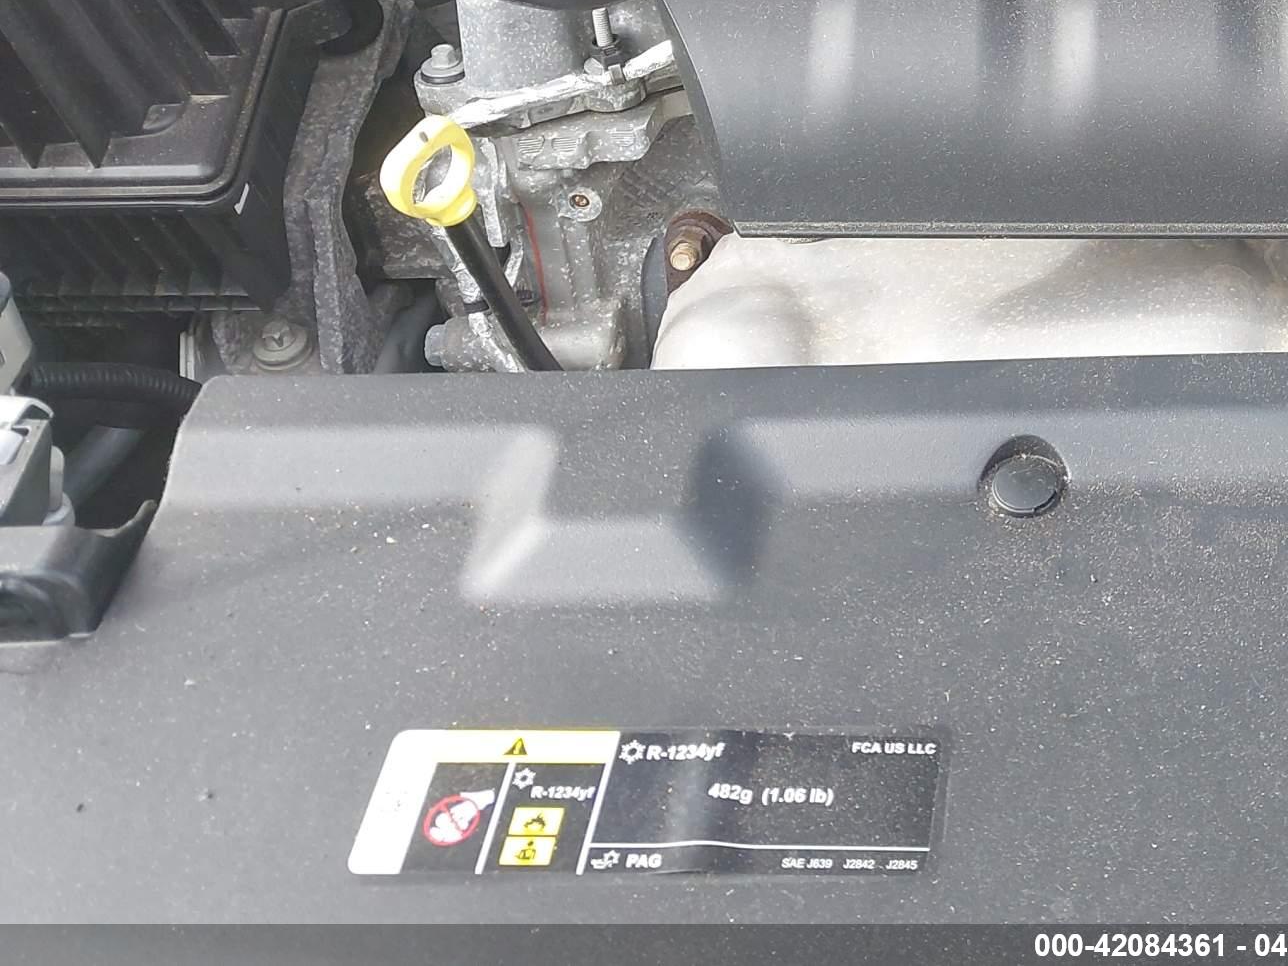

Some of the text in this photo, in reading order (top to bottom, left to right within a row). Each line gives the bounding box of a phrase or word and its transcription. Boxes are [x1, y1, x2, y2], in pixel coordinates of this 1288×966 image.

[646, 742, 726, 762] R-1234yf
[852, 742, 937, 754] FCA US LLC
[530, 786, 596, 801] R-1234yf
[708, 782, 835, 806] 482g (1.06 lb)
[626, 853, 662, 868] PAG
[781, 857, 918, 870] SAE J639 J2842 J2845
